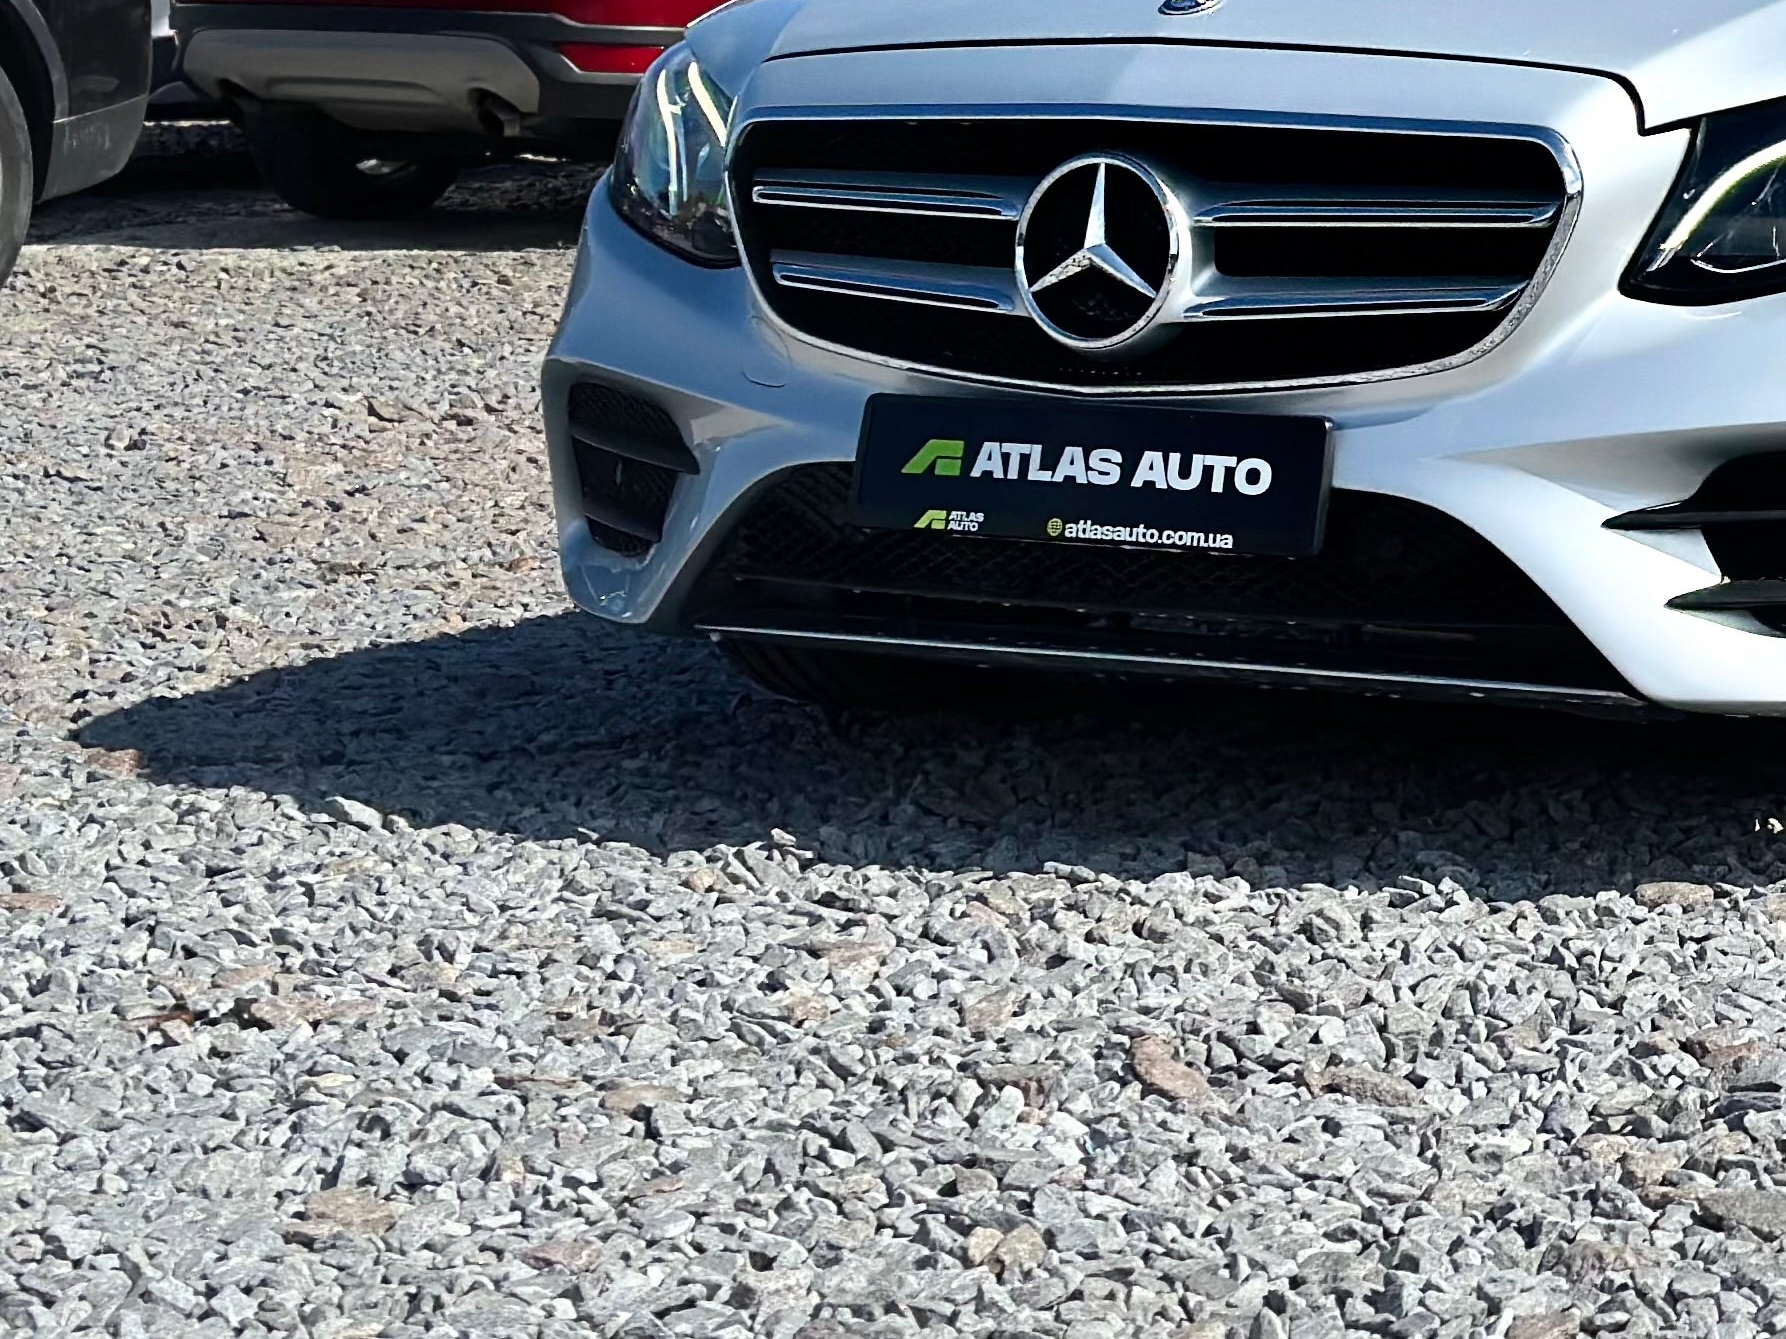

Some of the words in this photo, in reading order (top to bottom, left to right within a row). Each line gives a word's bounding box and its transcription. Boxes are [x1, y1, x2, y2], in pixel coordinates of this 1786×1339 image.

[969, 441, 1121, 486] ATLAS
[1130, 451, 1273, 495] AUTO
[947, 520, 979, 532] AUTO
[948, 510, 985, 522] ATLAS
[1064, 519, 1234, 549] atlasauto.com.ua
